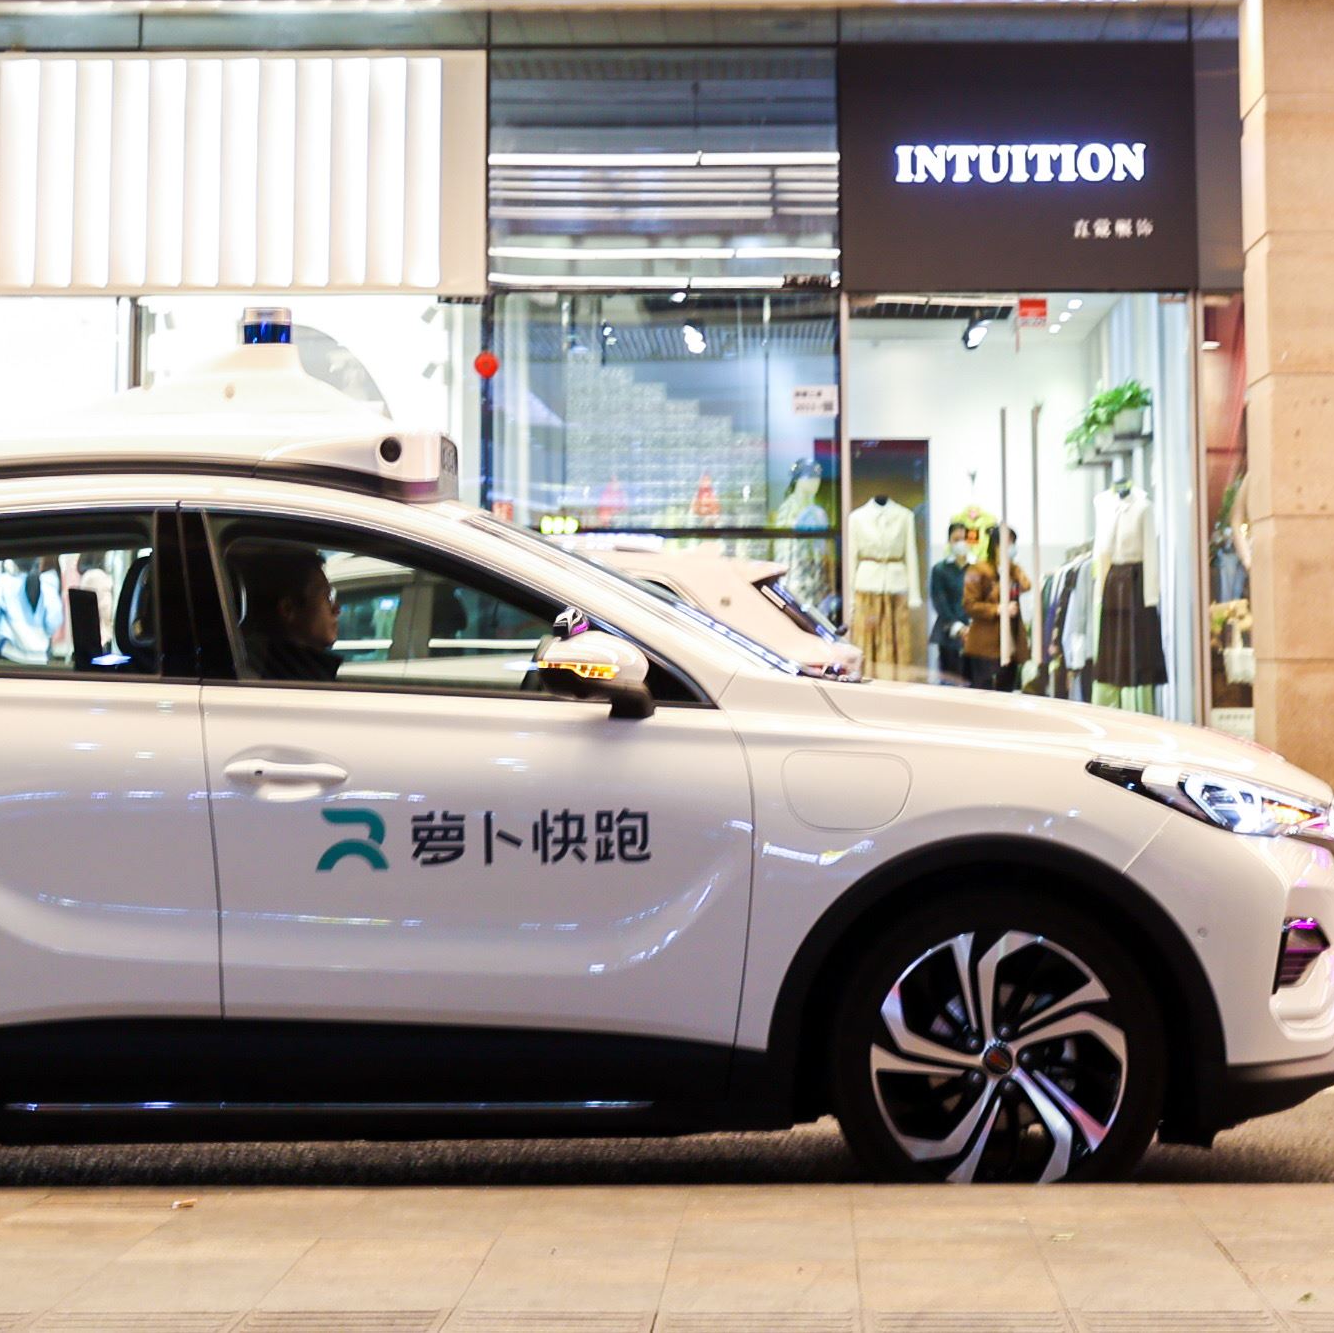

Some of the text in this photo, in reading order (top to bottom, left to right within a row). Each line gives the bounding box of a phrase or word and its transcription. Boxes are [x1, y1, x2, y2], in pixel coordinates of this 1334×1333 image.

[894, 142, 1147, 183] INTUITION
[411, 808, 652, 866] 萝卜快跑
